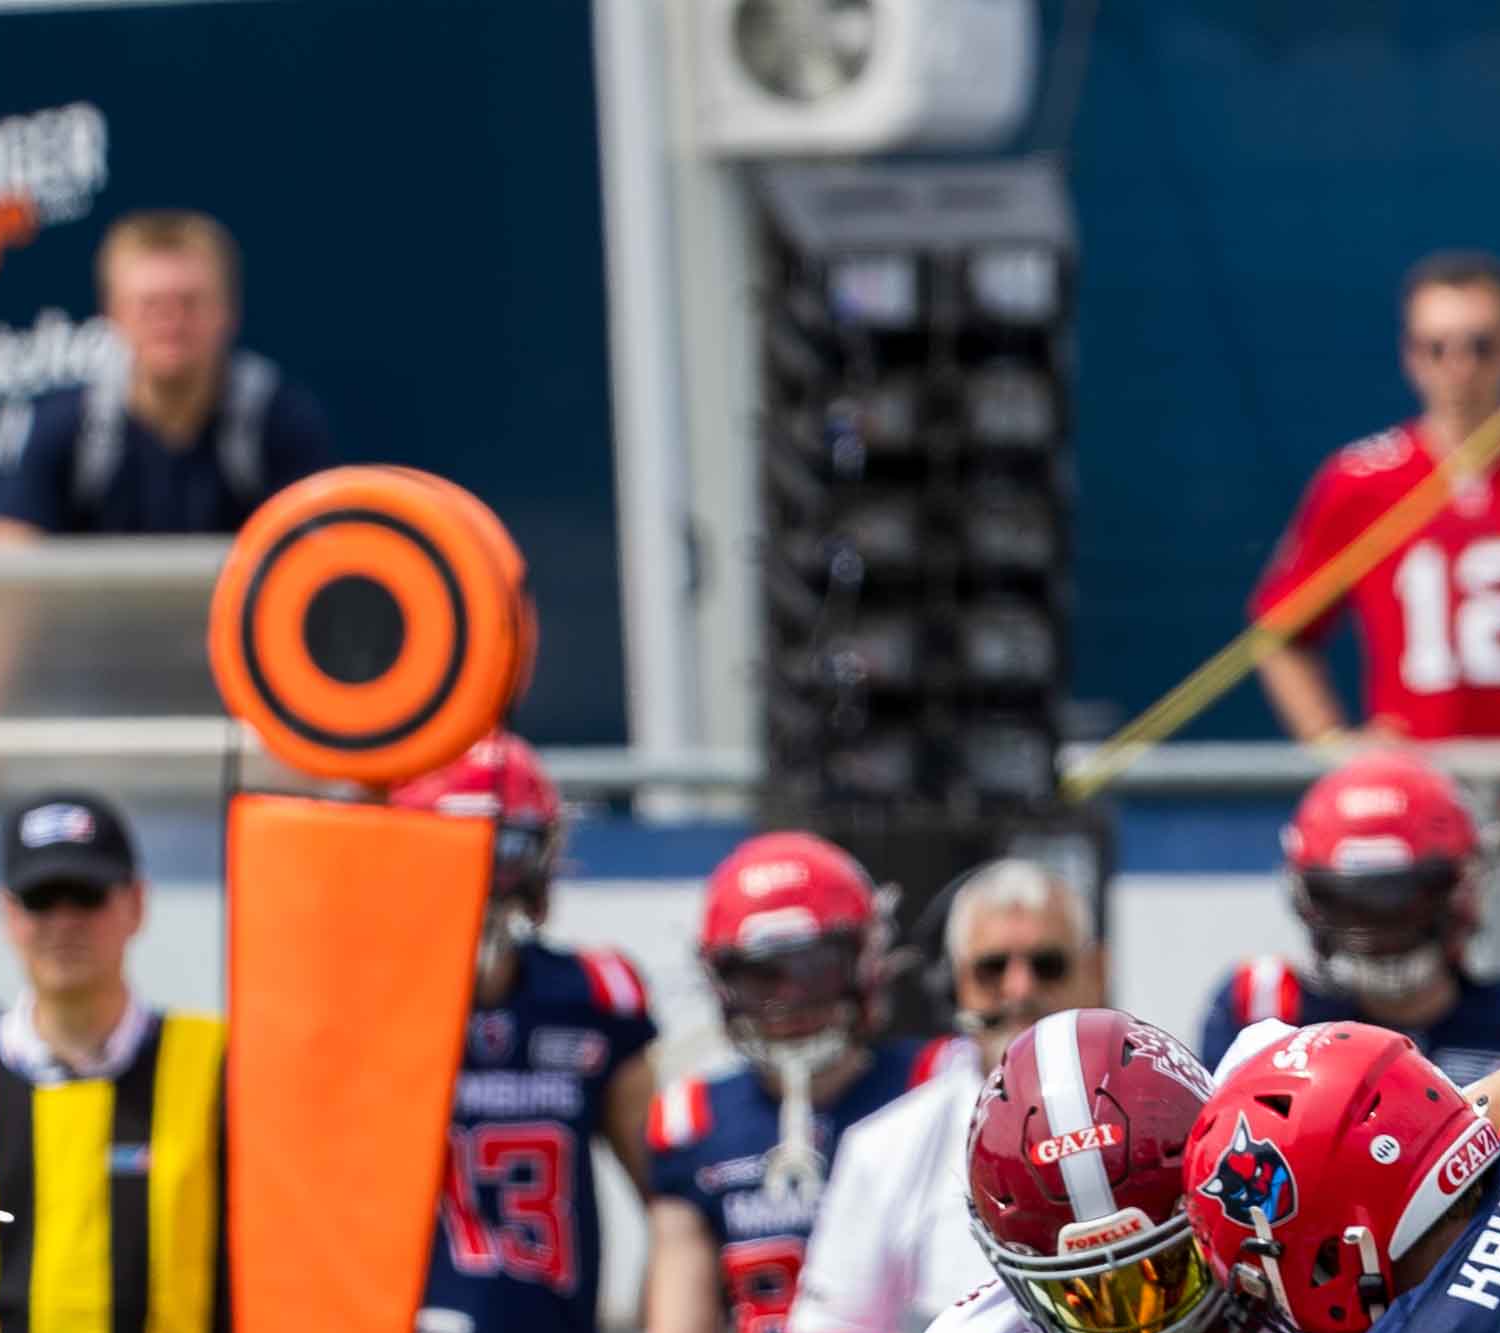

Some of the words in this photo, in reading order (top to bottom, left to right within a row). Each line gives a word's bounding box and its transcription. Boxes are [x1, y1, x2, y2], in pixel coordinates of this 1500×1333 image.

[1037, 1123, 1117, 1163] GAZI
[1446, 1124, 1500, 1187] GAZI
[1064, 1215, 1142, 1251] FORELLE
